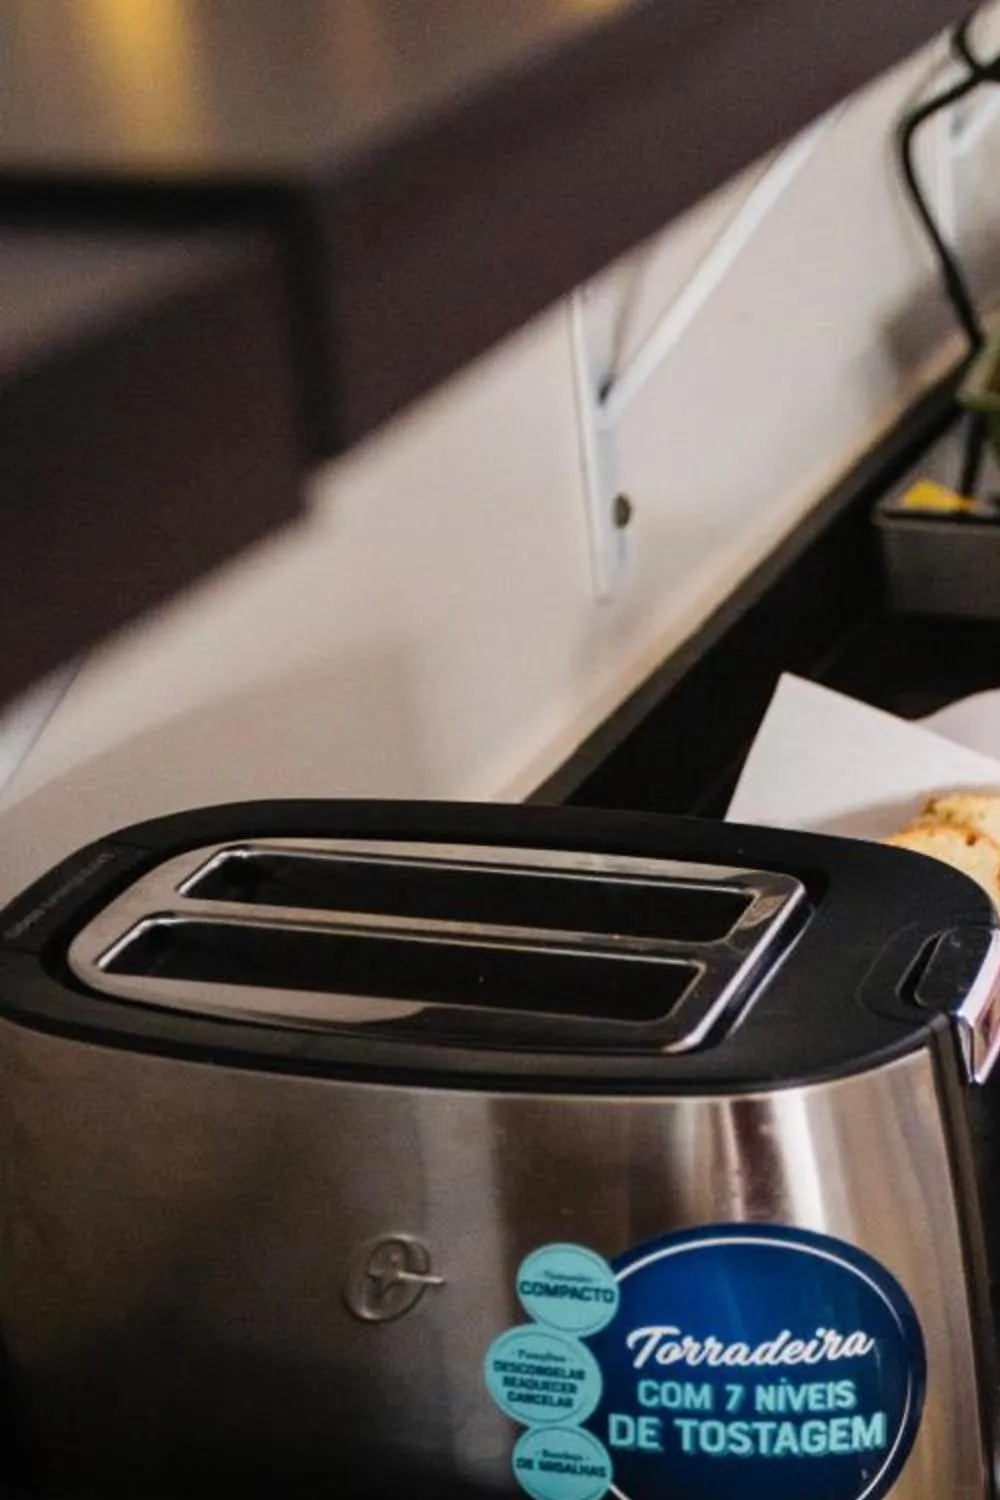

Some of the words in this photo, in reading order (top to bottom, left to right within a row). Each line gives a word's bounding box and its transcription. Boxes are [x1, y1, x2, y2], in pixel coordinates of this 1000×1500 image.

[520, 1280, 615, 1305] COMPACTO
[626, 1325, 875, 1369] Torradeira
[637, 1379, 713, 1411] COM
[724, 1384, 745, 1412] 7
[608, 1412, 663, 1451] DE
[674, 1411, 887, 1456] TOSTAGEM
